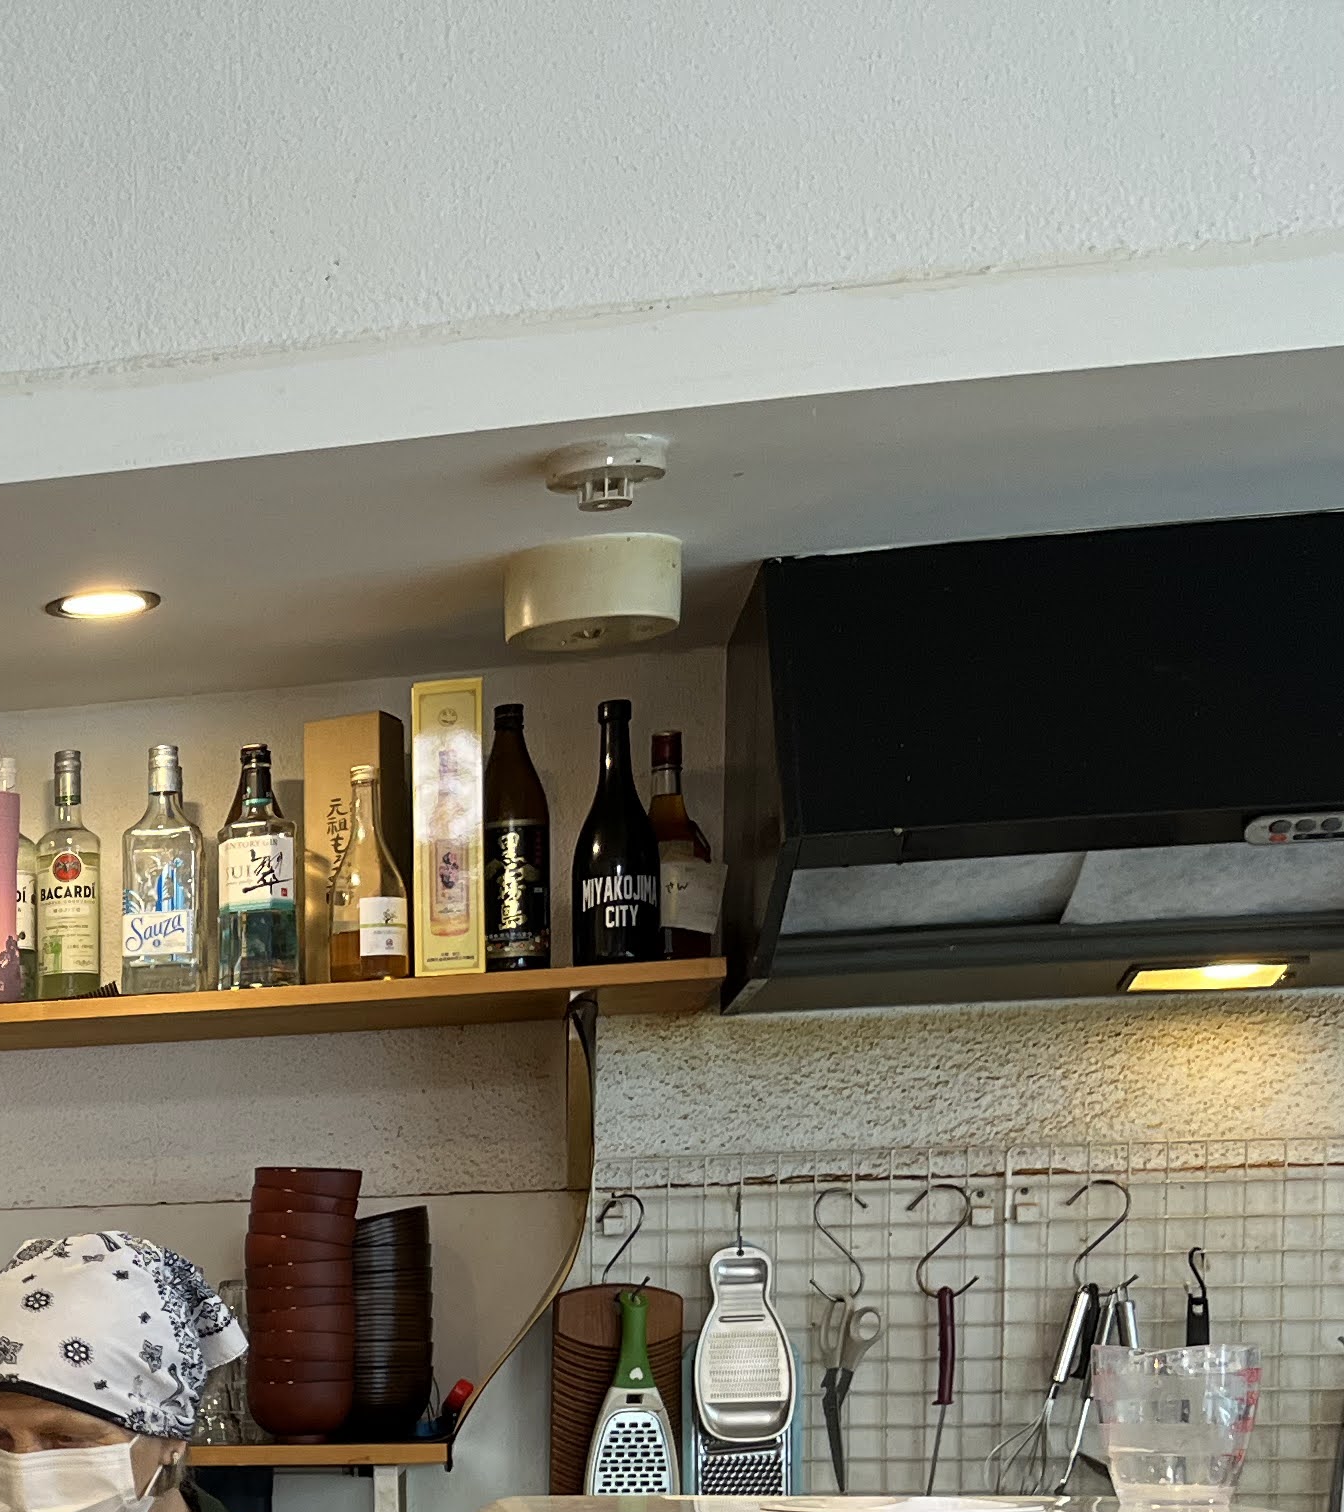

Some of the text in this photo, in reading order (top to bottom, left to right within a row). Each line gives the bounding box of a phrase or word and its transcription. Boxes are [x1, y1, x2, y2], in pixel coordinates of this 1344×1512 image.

[40, 882, 95, 901] BACARDÍ
[582, 874, 658, 912] MIYAKOJIMA
[605, 905, 639, 928] CITY
[125, 914, 185, 952] Sauza
